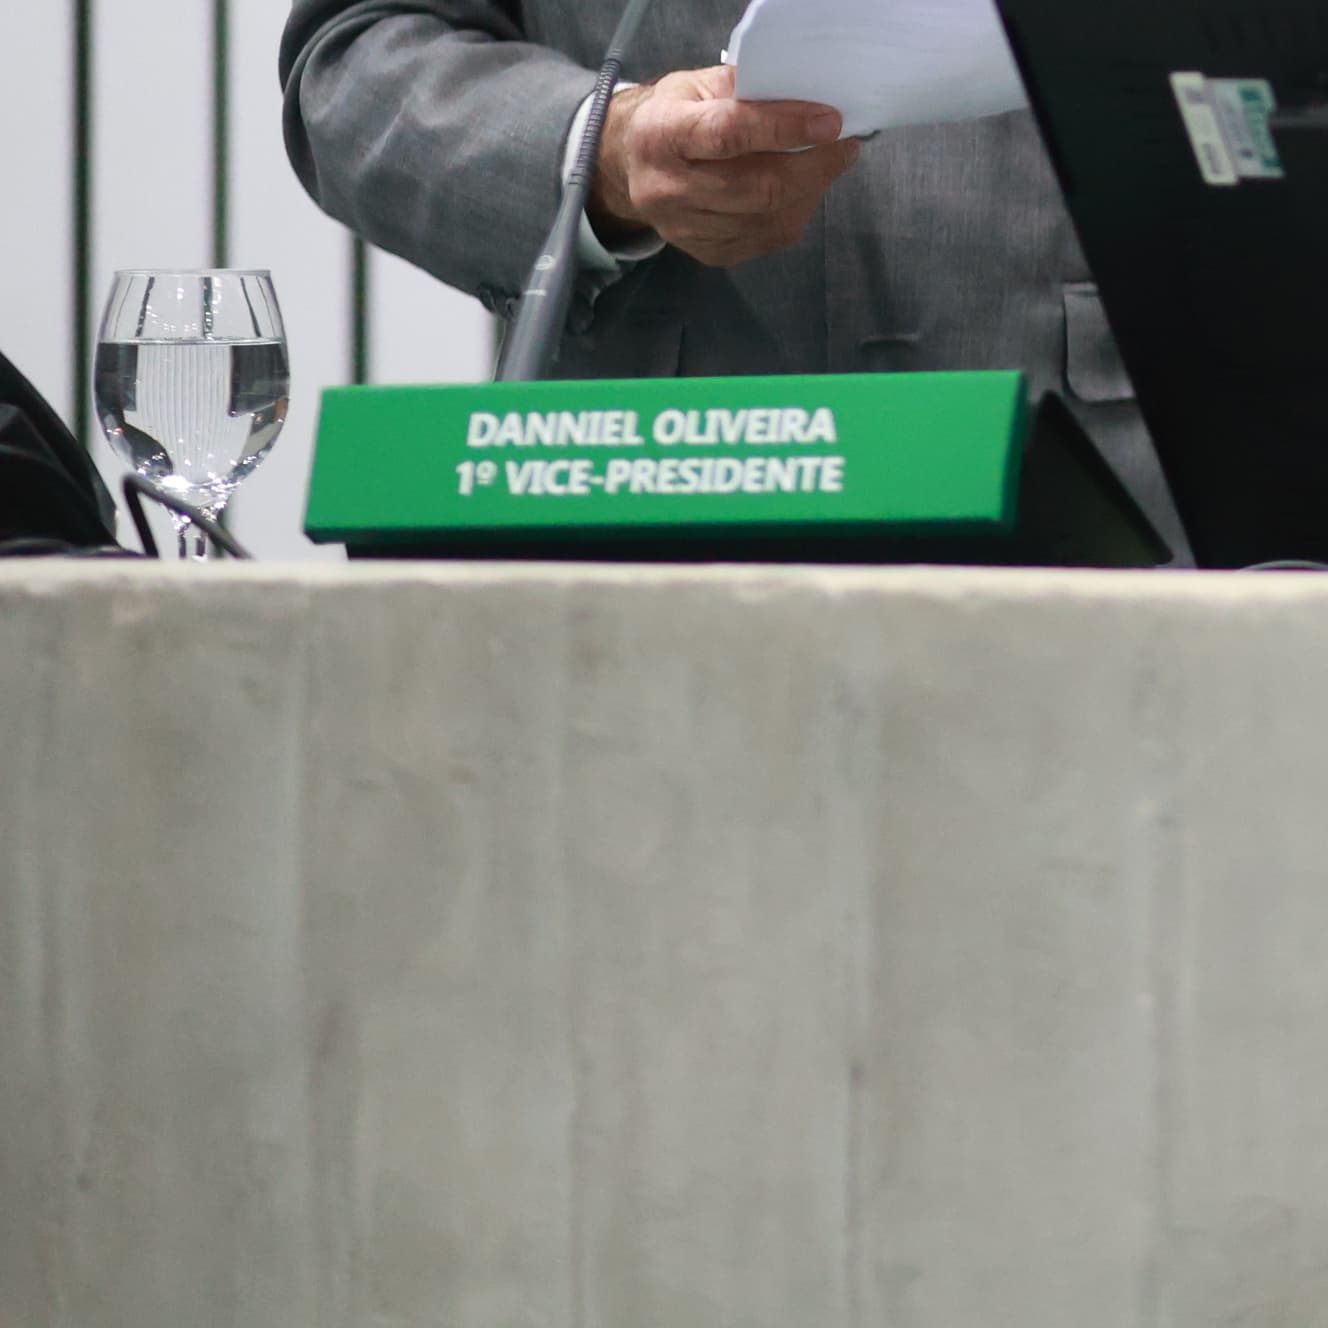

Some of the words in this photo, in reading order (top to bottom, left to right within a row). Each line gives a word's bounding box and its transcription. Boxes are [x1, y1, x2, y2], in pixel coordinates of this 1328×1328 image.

[467, 410, 644, 448] DANNIEL
[653, 407, 837, 445] OLIVEIRA
[505, 456, 845, 496] VICE-PRESIDENTE
